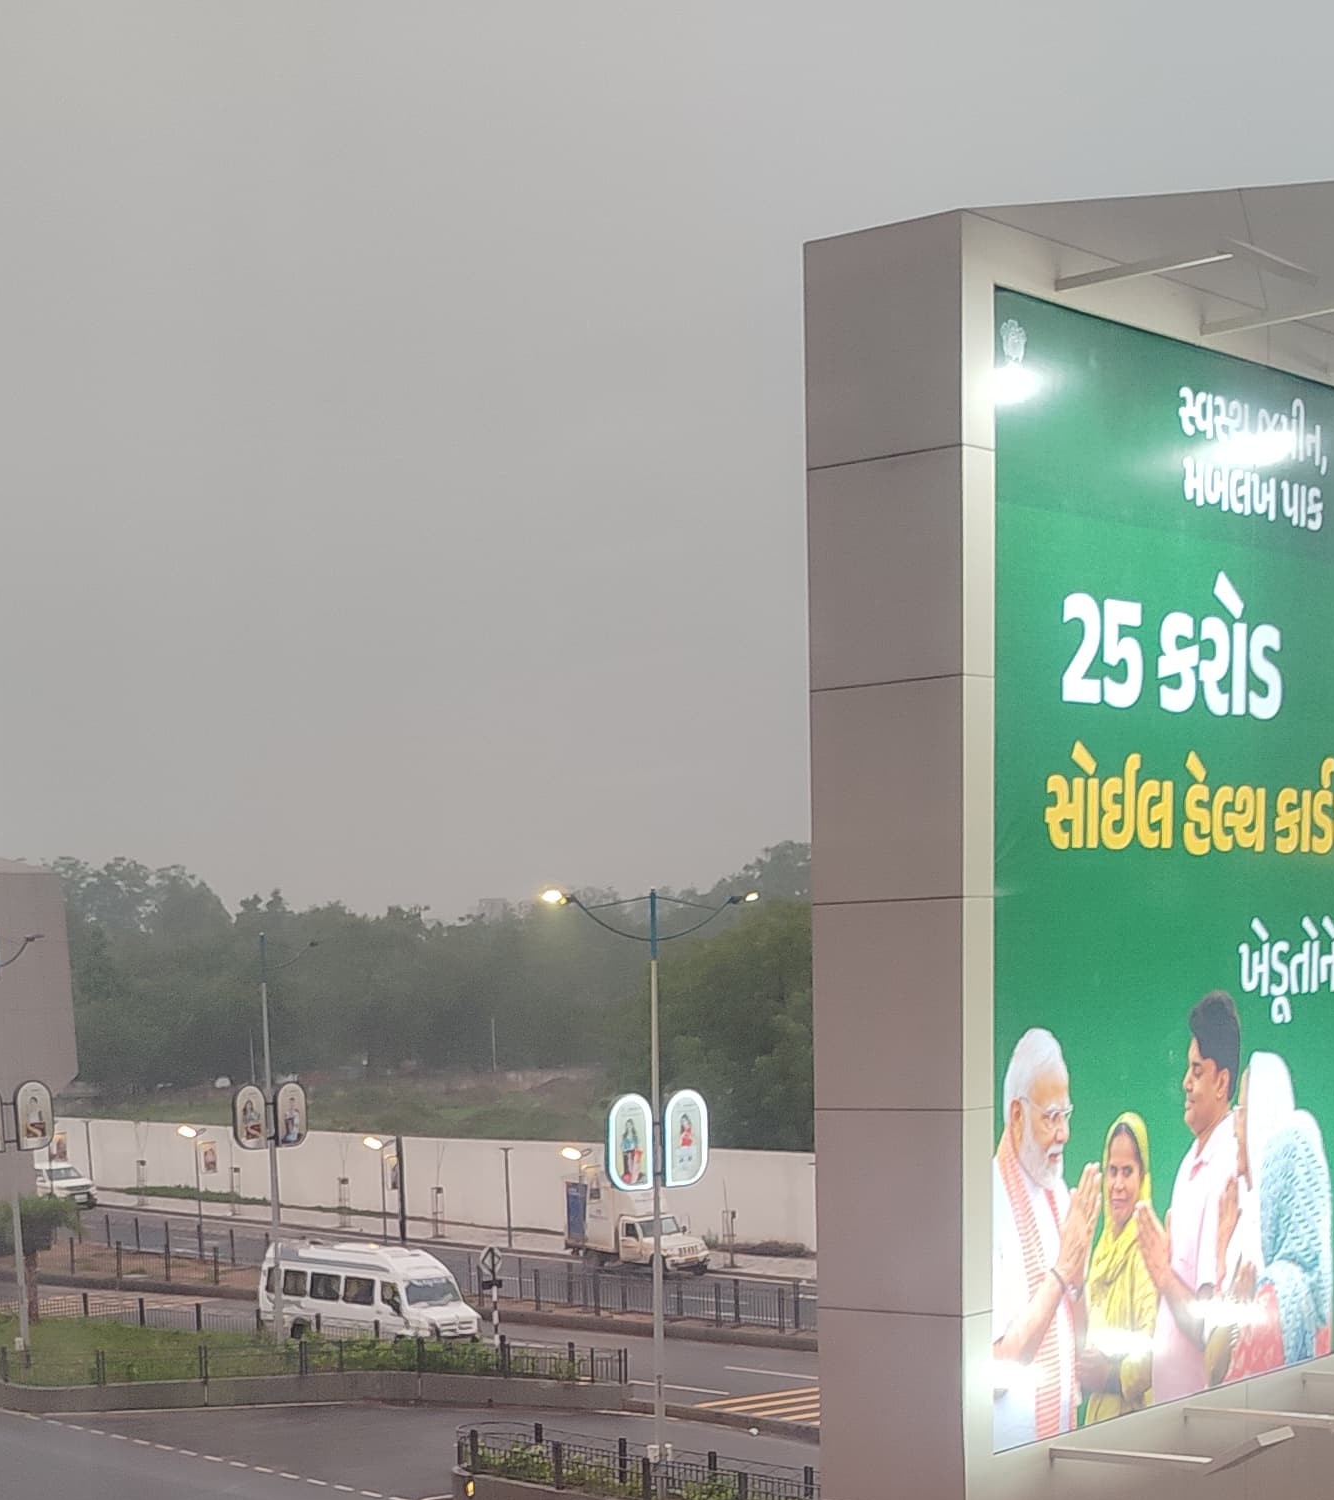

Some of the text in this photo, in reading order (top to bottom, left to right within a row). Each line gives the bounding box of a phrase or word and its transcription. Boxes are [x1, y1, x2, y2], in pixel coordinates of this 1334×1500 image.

[1280, 479, 1324, 531] પાક
[1061, 570, 1282, 720] 25 કરોડ
[1044, 739, 1175, 851] સોઈલ
[1183, 749, 1267, 857] હેલ્થ
